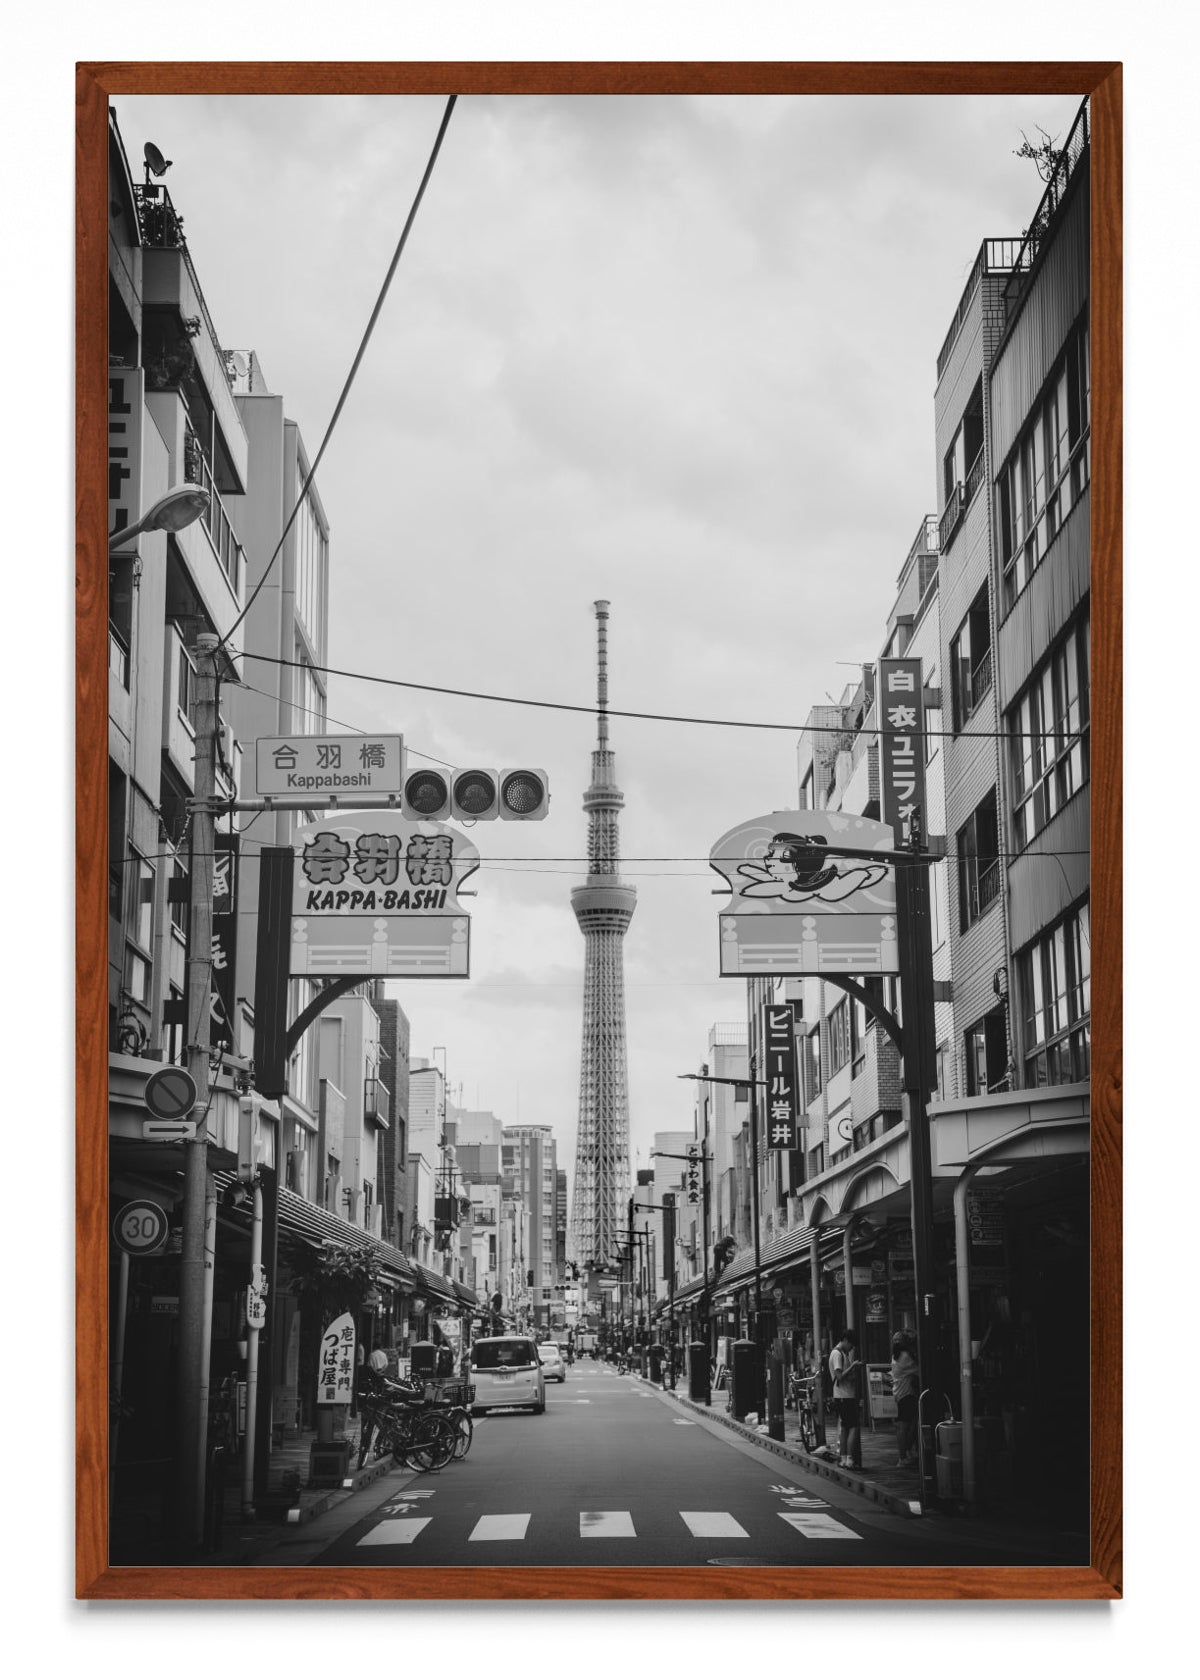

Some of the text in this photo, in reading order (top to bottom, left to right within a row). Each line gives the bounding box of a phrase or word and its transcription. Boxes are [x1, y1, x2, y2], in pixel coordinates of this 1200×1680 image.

[272, 744, 386, 770] 合羽橋
[287, 772, 371, 789] Kappabashi
[302, 832, 454, 886] 合羽橋
[769, 1010, 792, 1145] ビニール岩井
[126, 1215, 156, 1239] 30
[320, 1333, 340, 1386] つば屋
